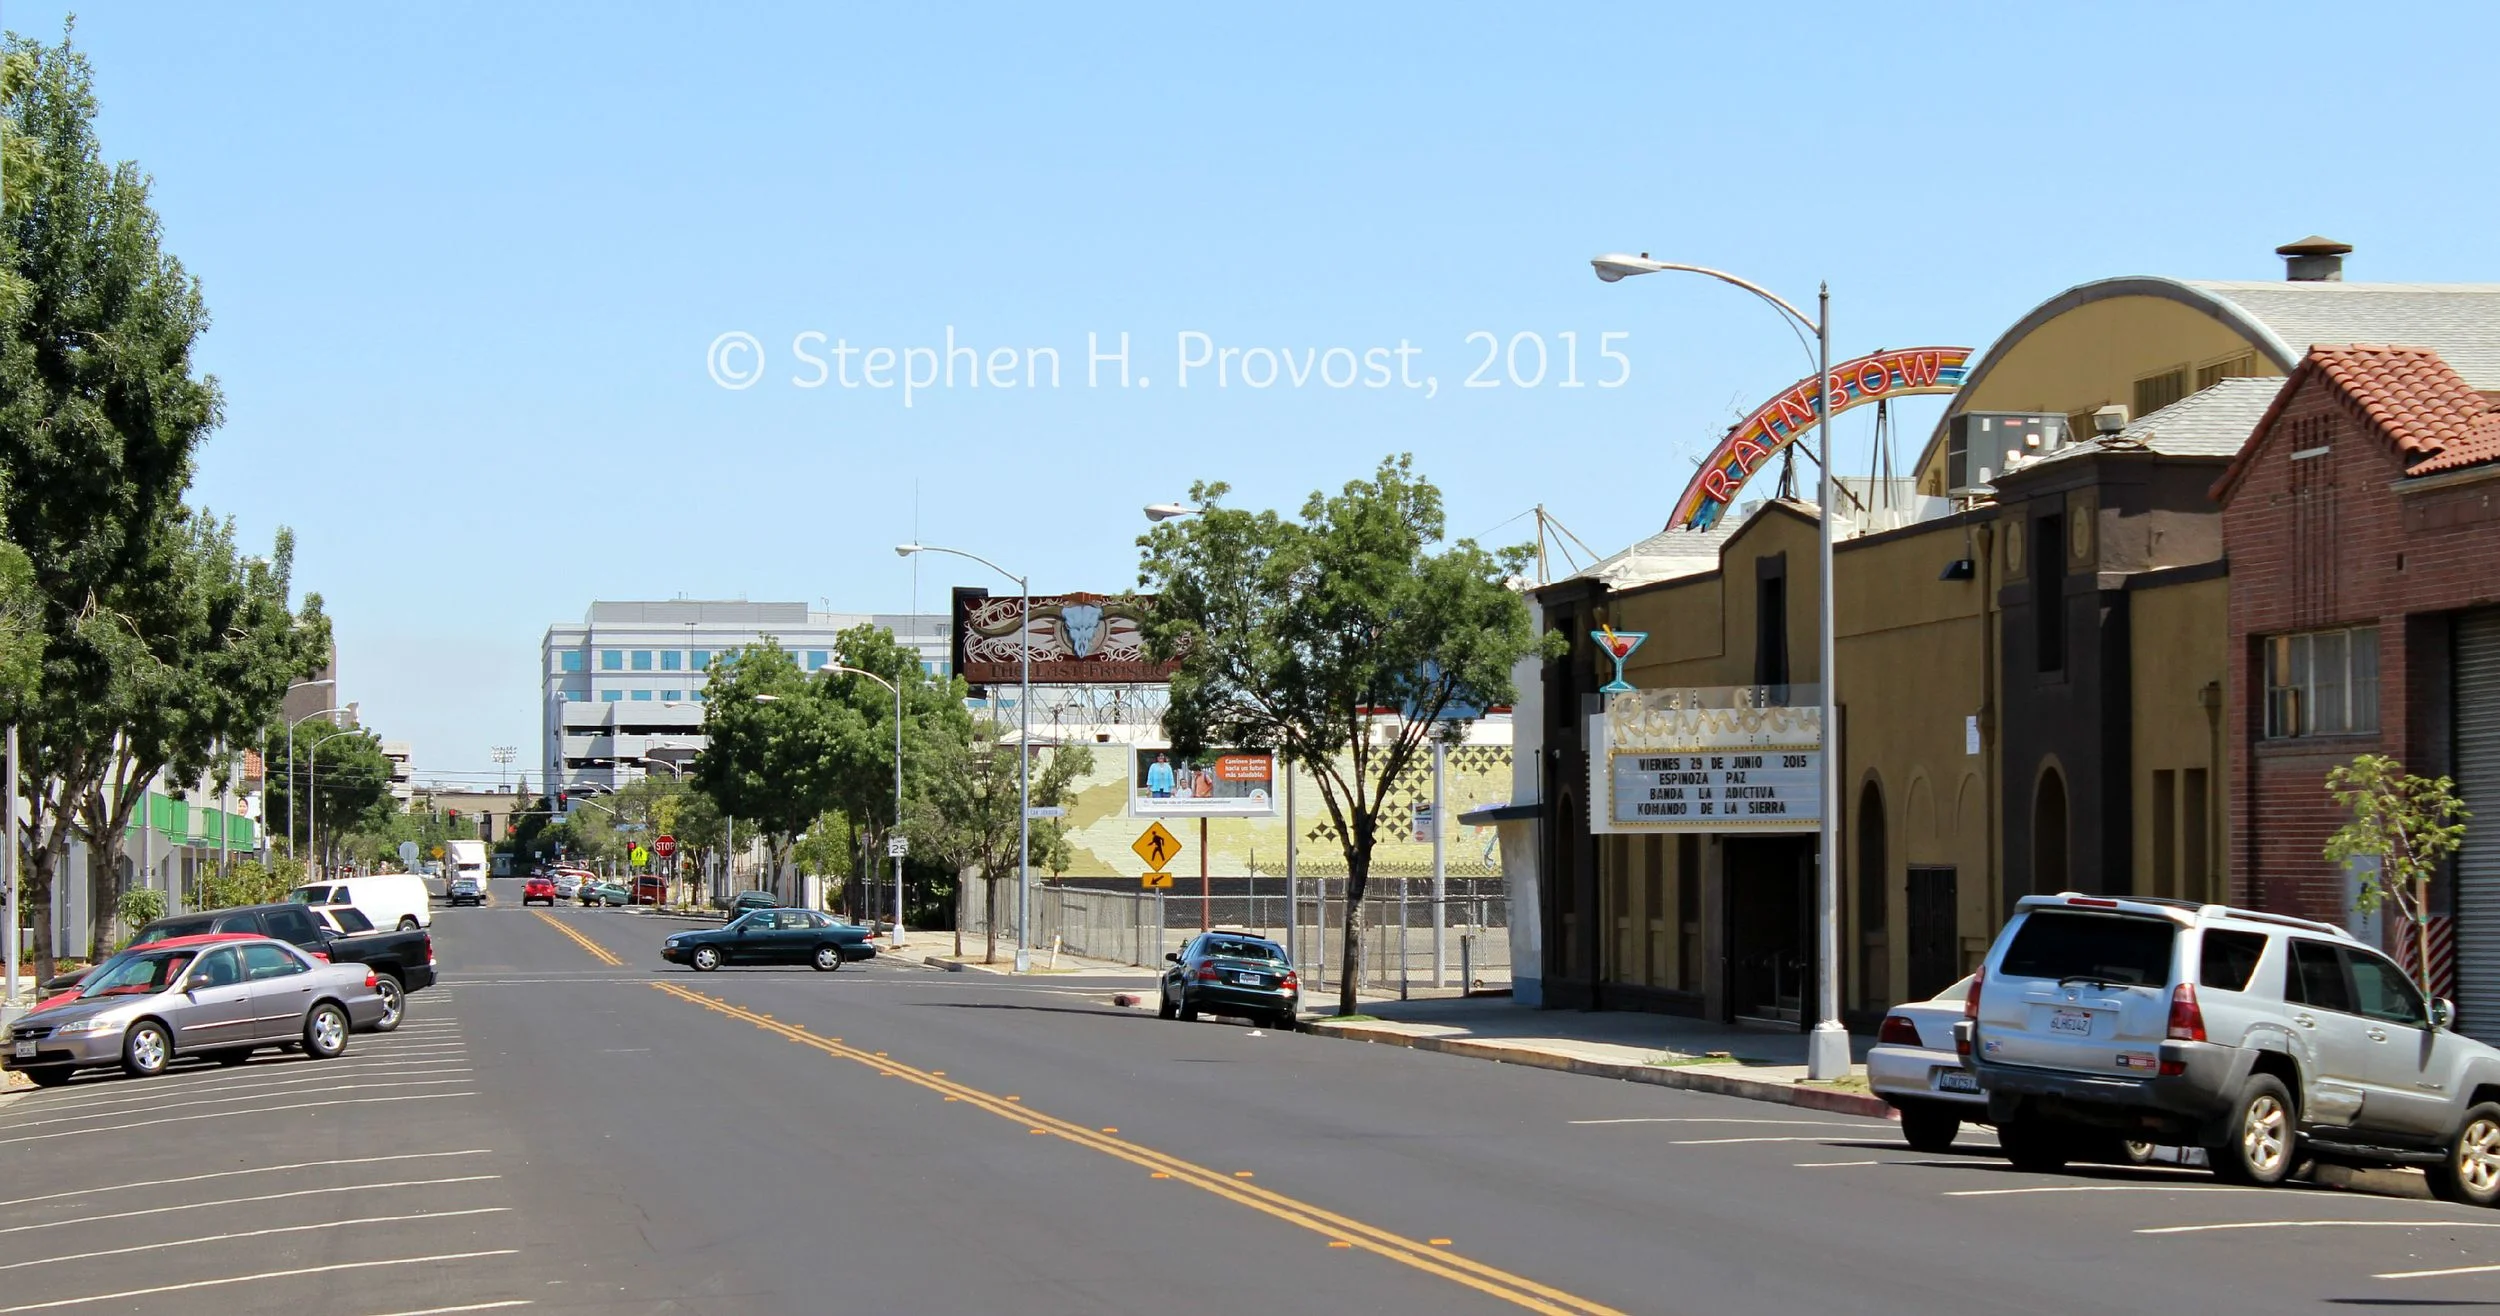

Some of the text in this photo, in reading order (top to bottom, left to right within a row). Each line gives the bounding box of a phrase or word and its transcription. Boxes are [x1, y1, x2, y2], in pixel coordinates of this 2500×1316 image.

[1703, 352, 1941, 504] RAINBOW
[1639, 755, 1807, 771] VIERNES 29 DE JUNIO 2015
[1659, 771, 1746, 785] ESPINOZA PAZ
[1650, 786, 1775, 800] BANDA LA ADICTIVA
[1637, 802, 1786, 815] KOMANDO DE LA SIERRA
[656, 842, 675, 851] STOP
[892, 845, 906, 854] 25
